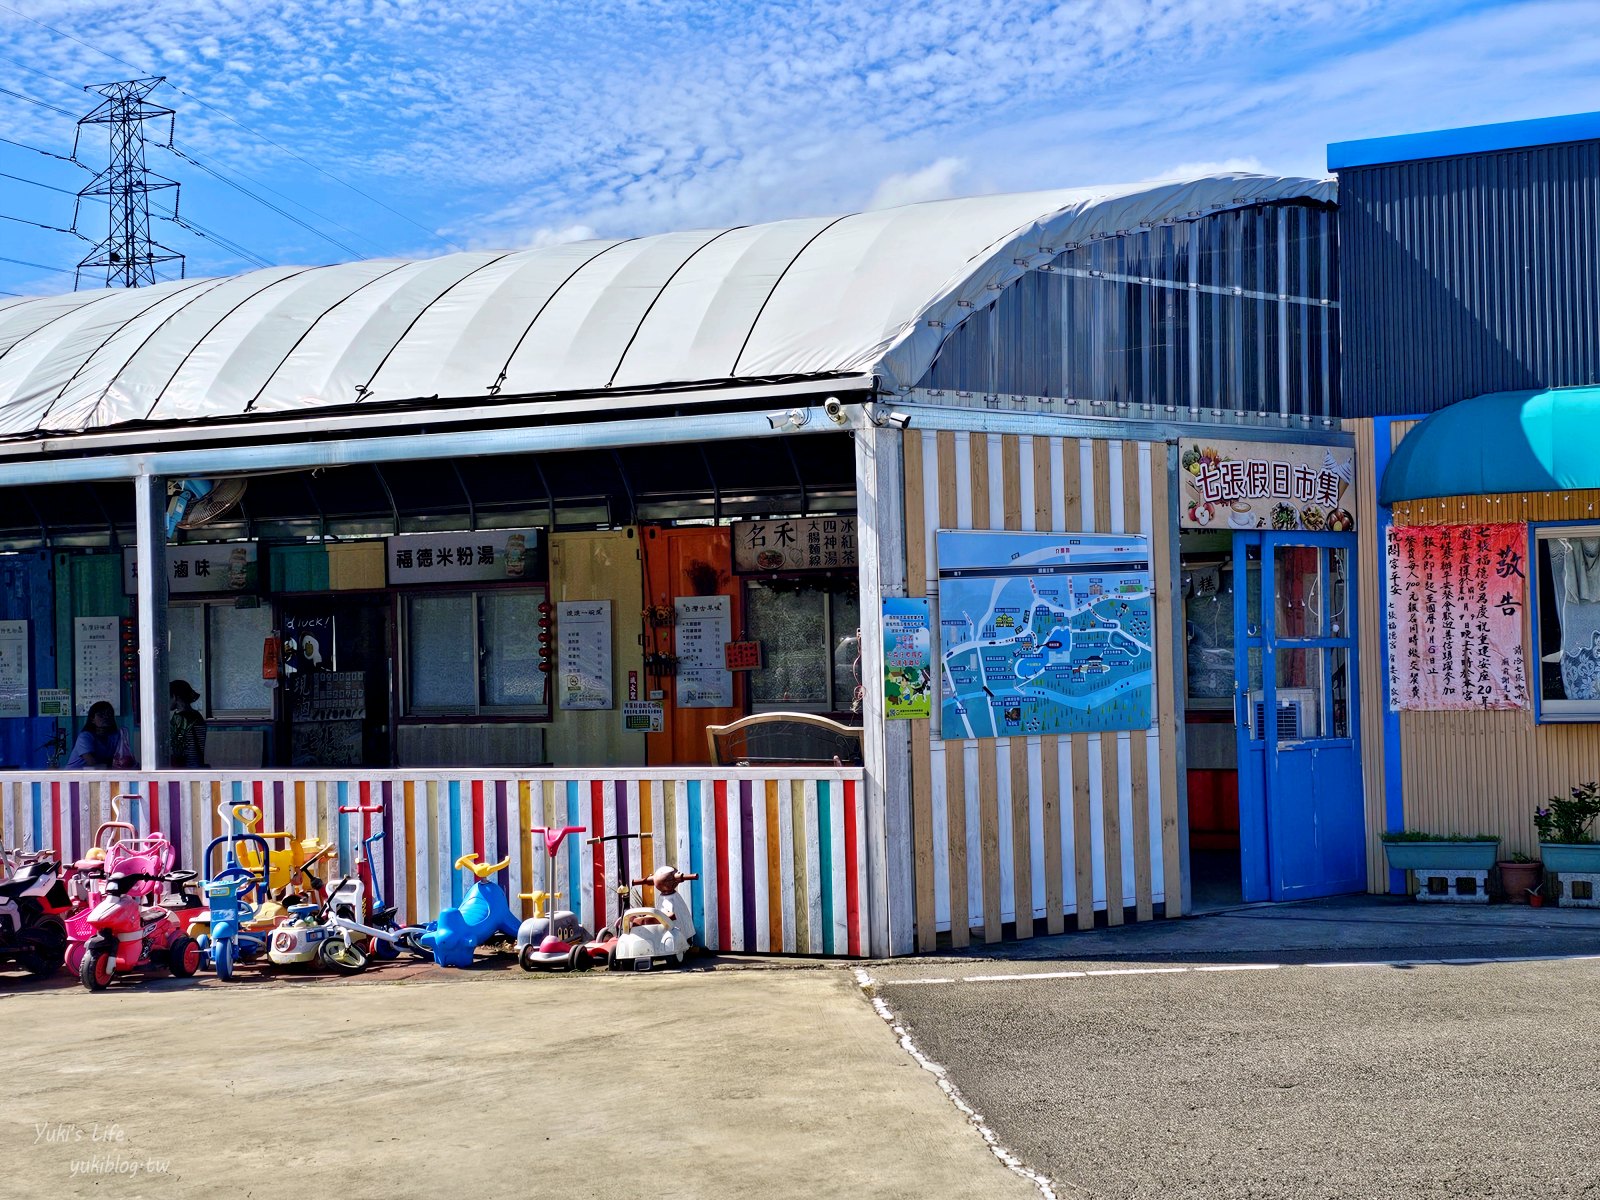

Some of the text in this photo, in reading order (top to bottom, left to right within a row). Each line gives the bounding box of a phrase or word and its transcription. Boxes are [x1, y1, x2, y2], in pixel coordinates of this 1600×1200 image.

[1196, 459, 1341, 509] 七張假日市集
[396, 545, 495, 569] 福德米粉湯
[745, 522, 795, 549] 名禾
[808, 520, 821, 567] 大腸麵線
[823, 520, 838, 566] 四神湯
[840, 518, 856, 565] 冰紅茶
[1494, 544, 1525, 616] 敬告
